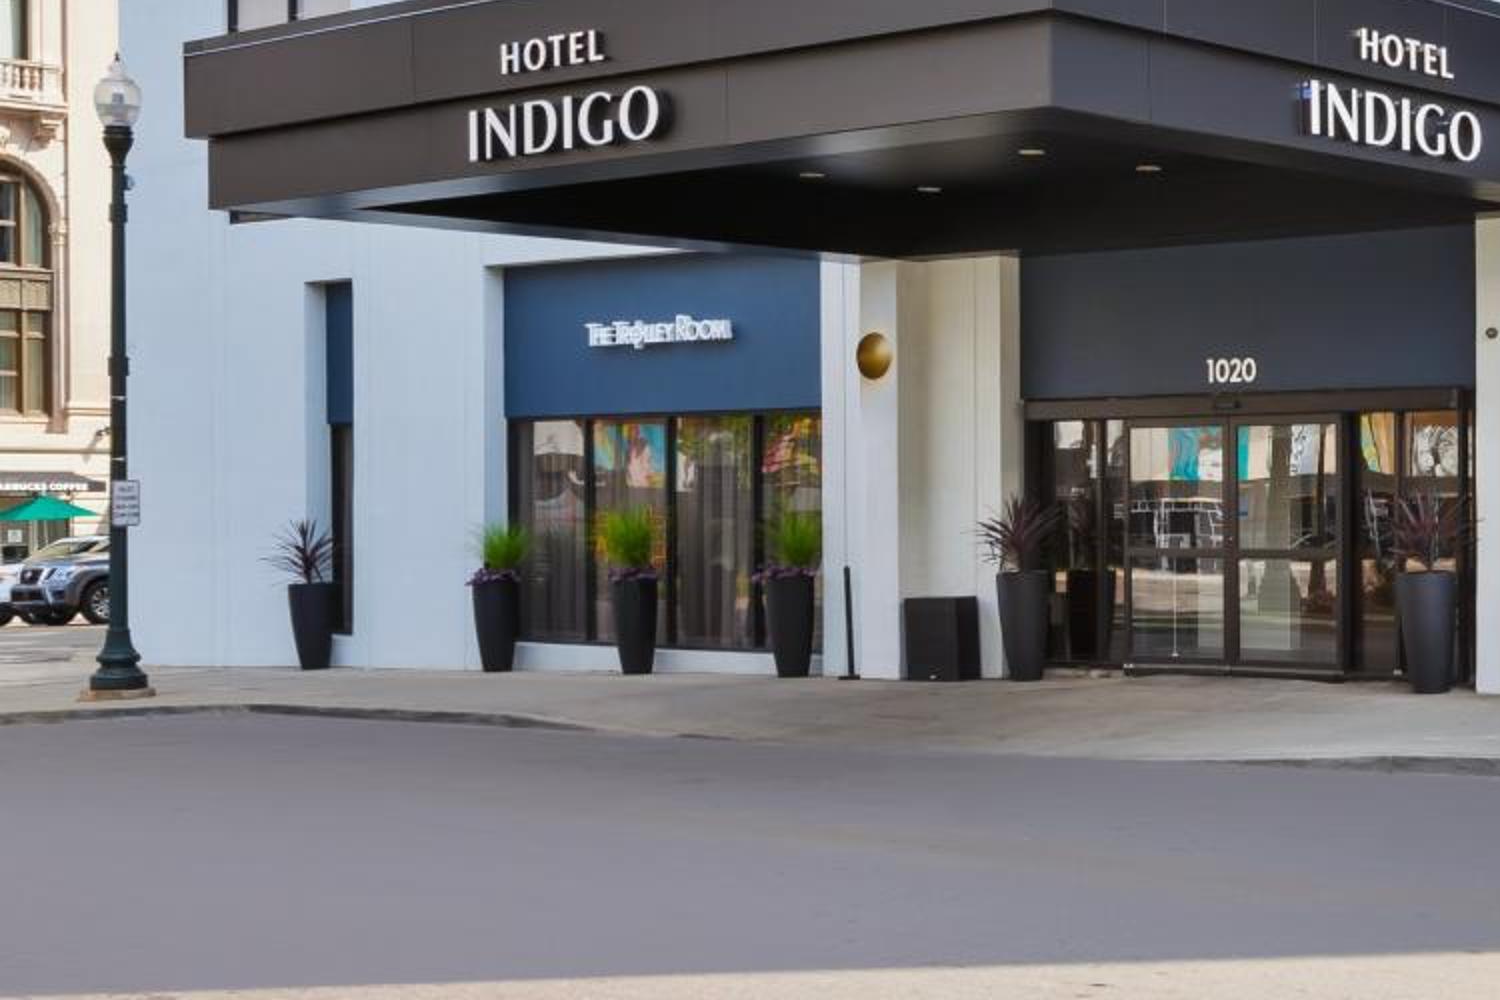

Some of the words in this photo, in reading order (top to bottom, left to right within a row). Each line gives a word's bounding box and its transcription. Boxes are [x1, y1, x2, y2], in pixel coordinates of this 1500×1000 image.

[500, 29, 604, 75] HOTEL
[1358, 27, 1455, 79] HOTEL
[468, 85, 659, 162] INDIGO
[1309, 79, 1482, 162] INDIGO
[585, 323, 616, 346] THE
[675, 314, 733, 342] ROOM
[1206, 357, 1257, 384] 1020
